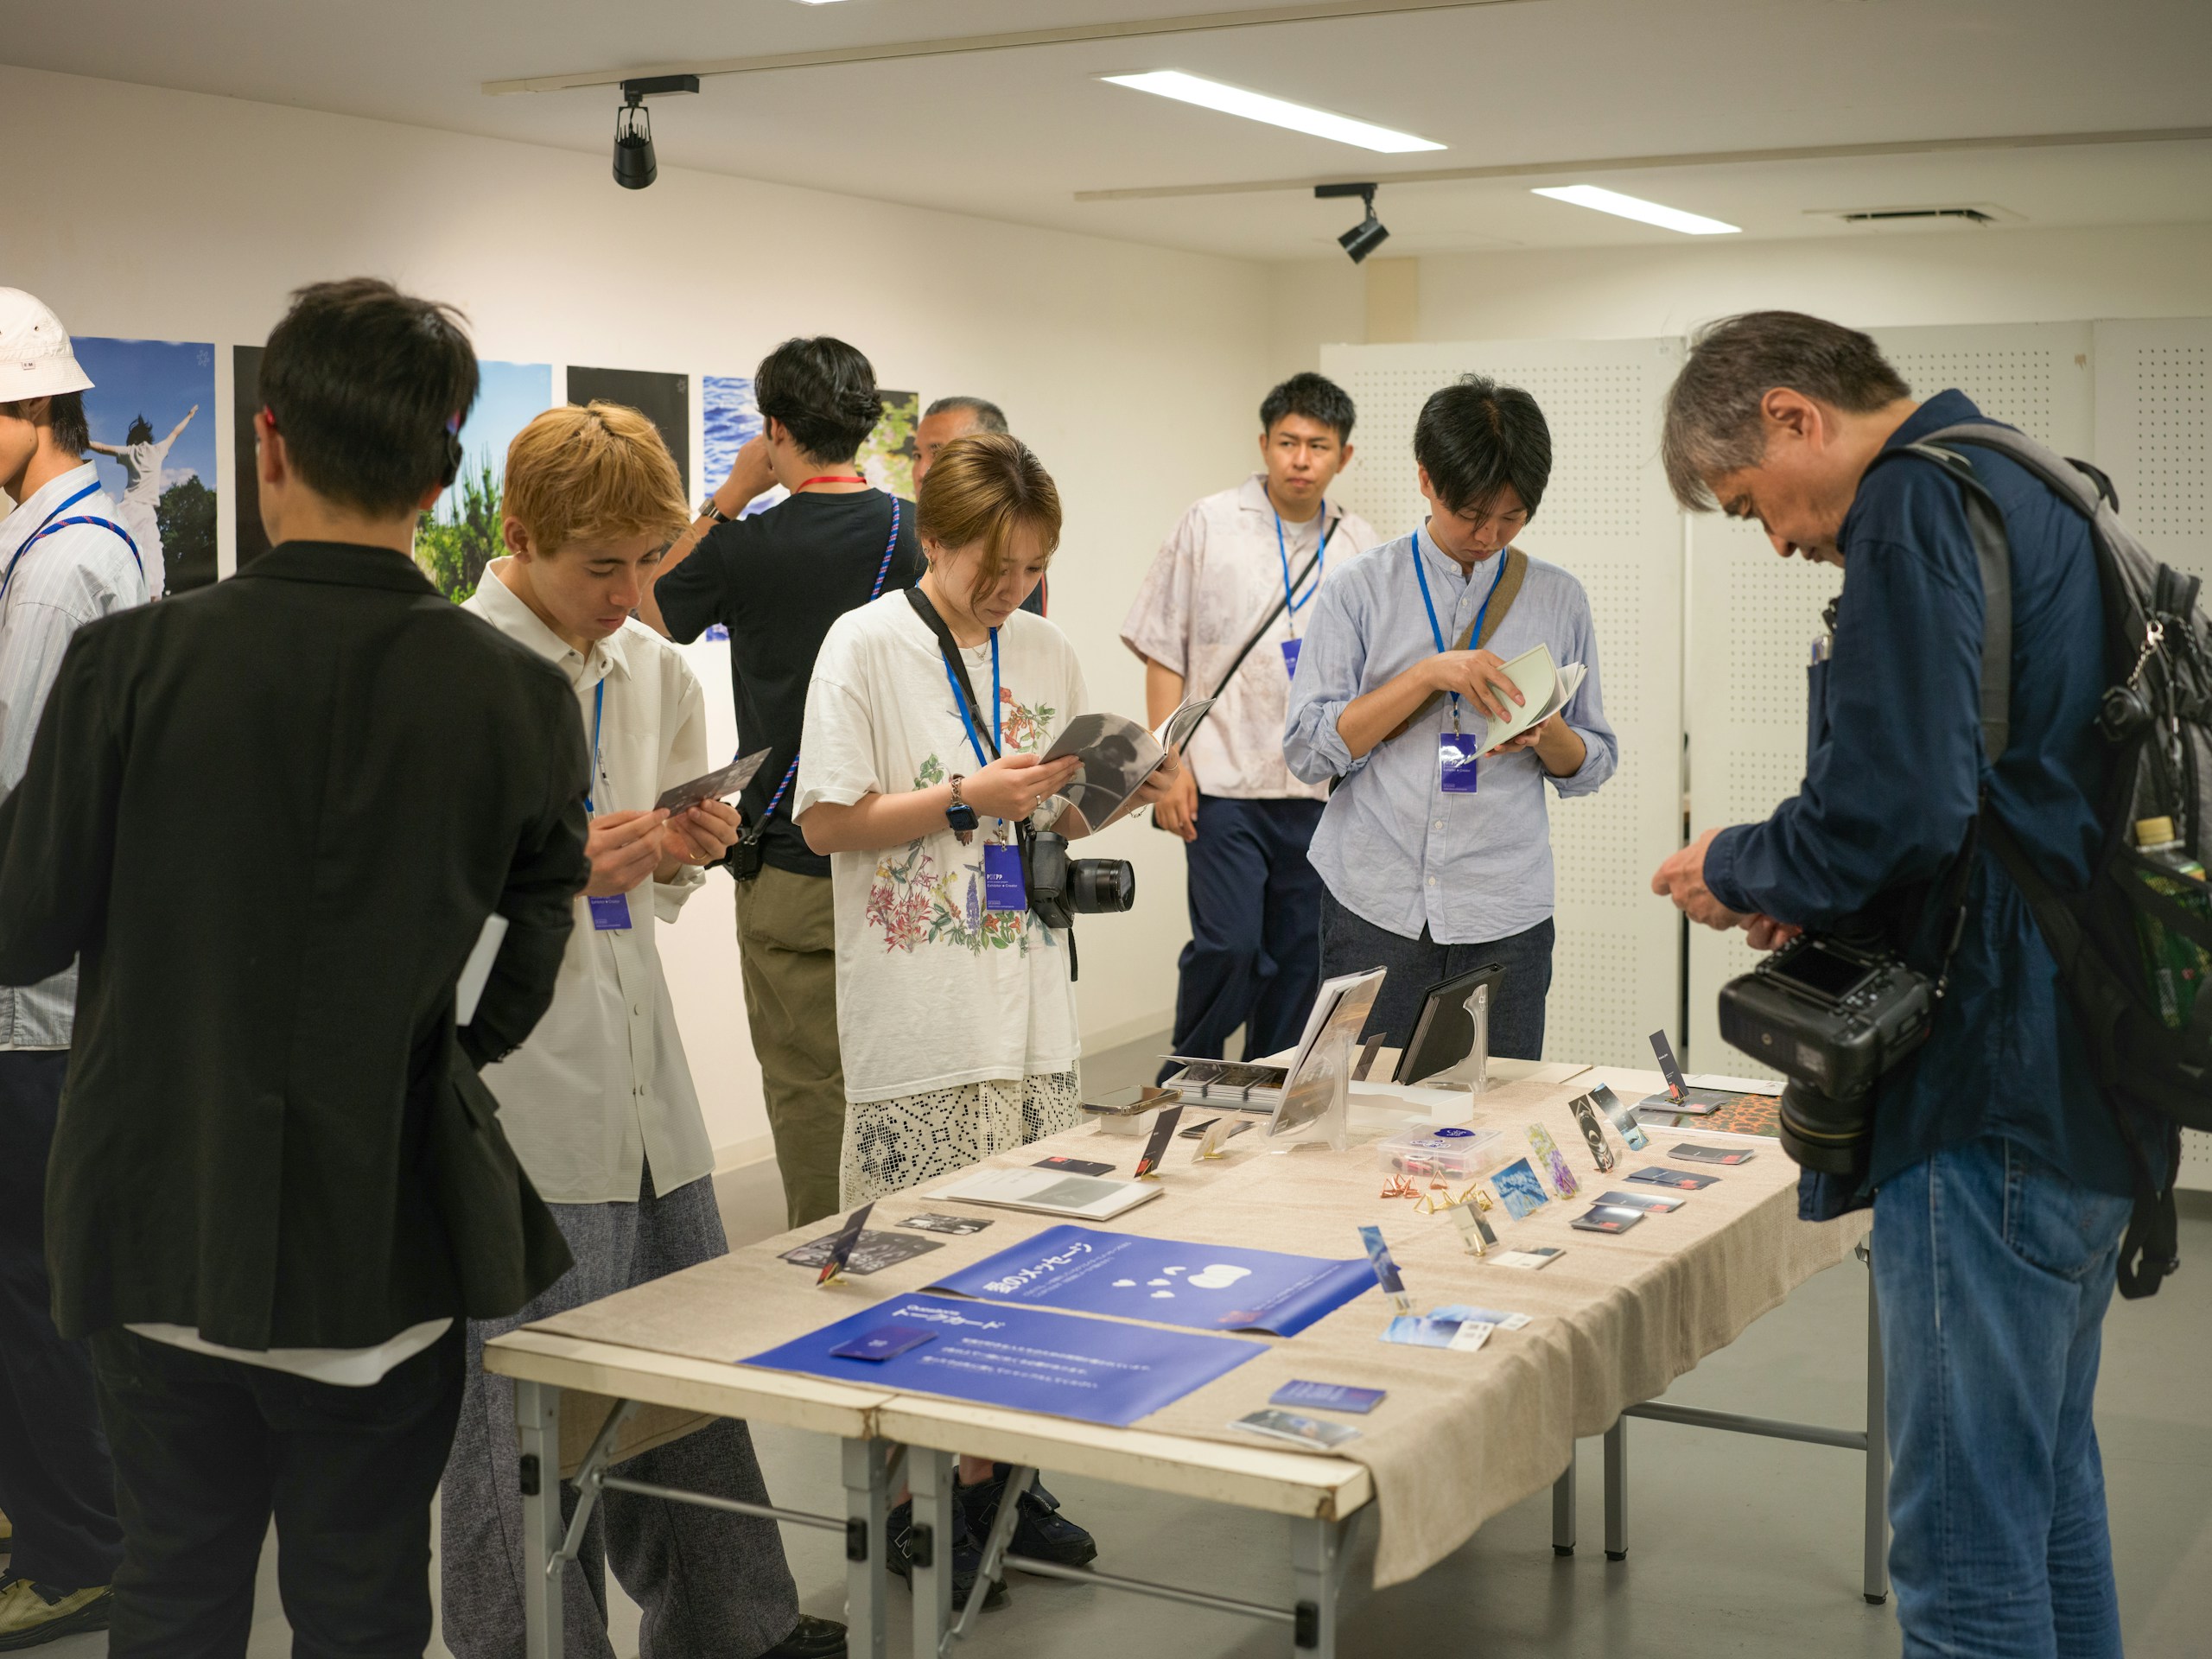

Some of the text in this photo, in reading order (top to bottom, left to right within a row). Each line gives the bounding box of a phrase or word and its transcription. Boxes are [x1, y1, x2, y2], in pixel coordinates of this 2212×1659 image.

[982, 1242, 1092, 1294] 愛のメッセージ
[892, 1308, 1006, 1330] トークカード
